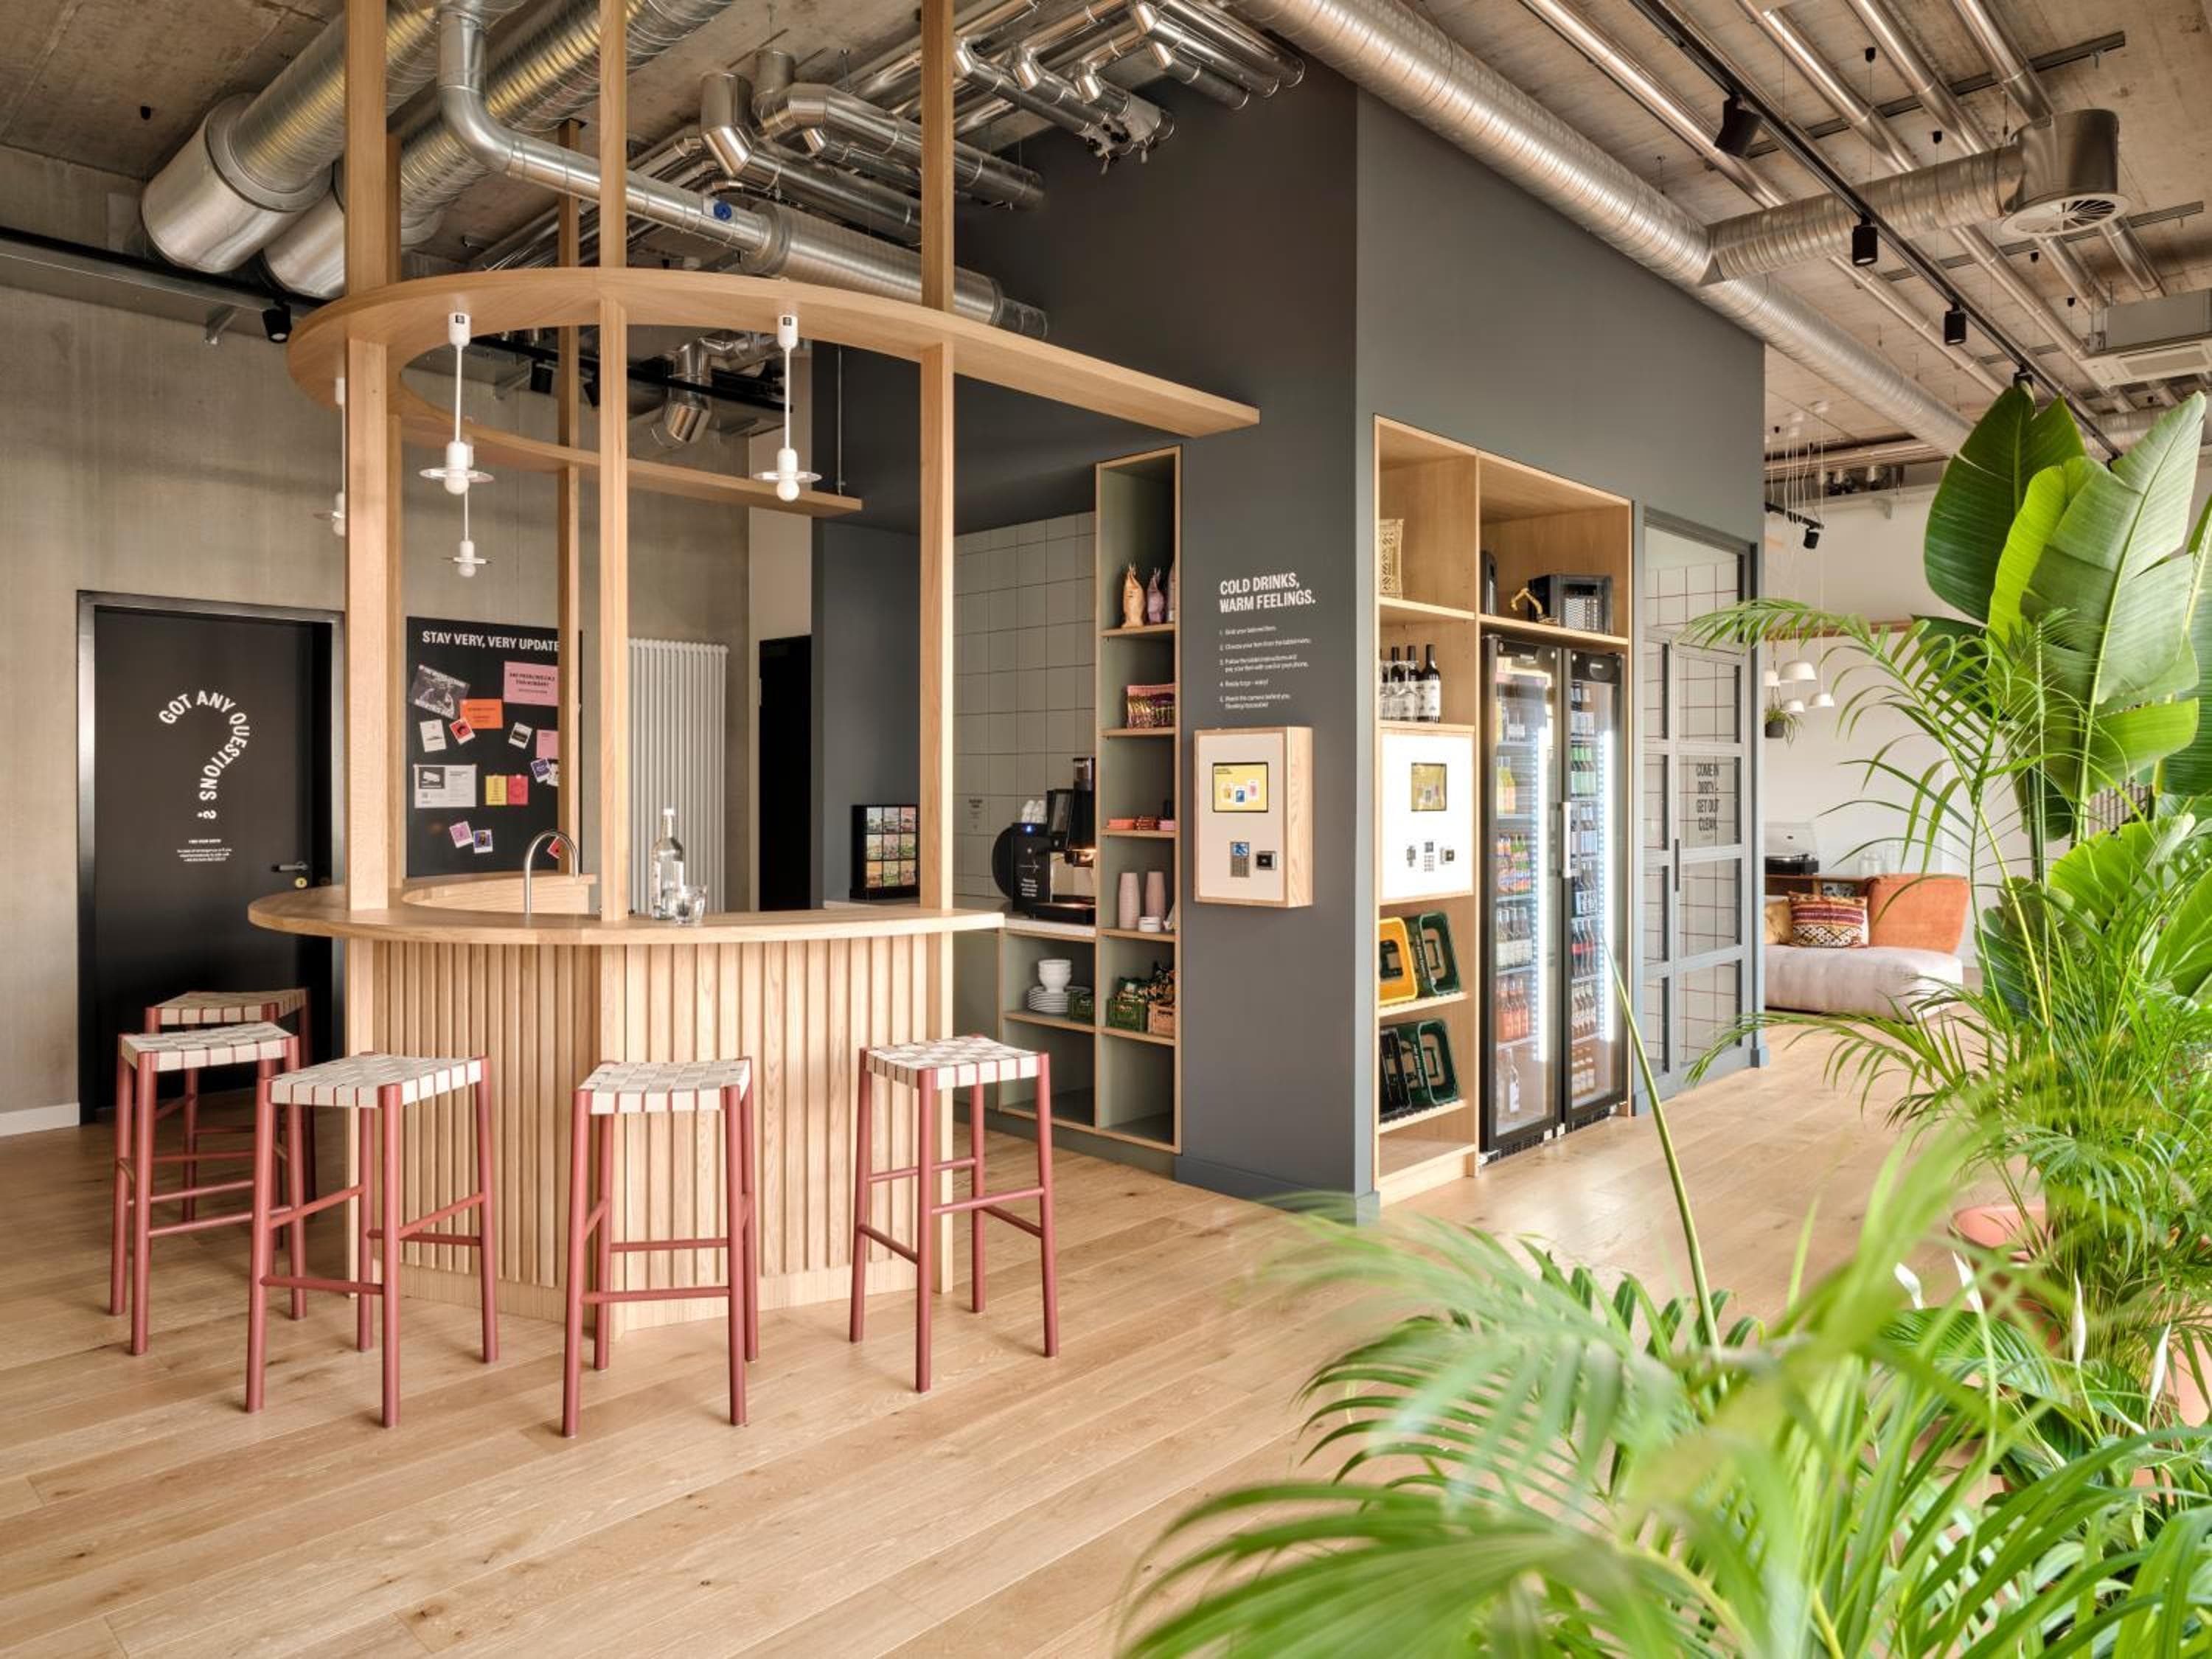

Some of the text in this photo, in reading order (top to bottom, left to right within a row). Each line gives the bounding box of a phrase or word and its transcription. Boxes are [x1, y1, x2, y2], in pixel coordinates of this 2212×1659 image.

[1220, 571, 1300, 596] COLD DRINKS,
[1219, 589, 1316, 613] WARM FEELINGS.
[422, 630, 560, 652] STAY VERY, VERY UPDATE
[159, 692, 192, 725] GOT
[196, 690, 237, 713] ANY
[198, 712, 251, 801] QUESTIONS
